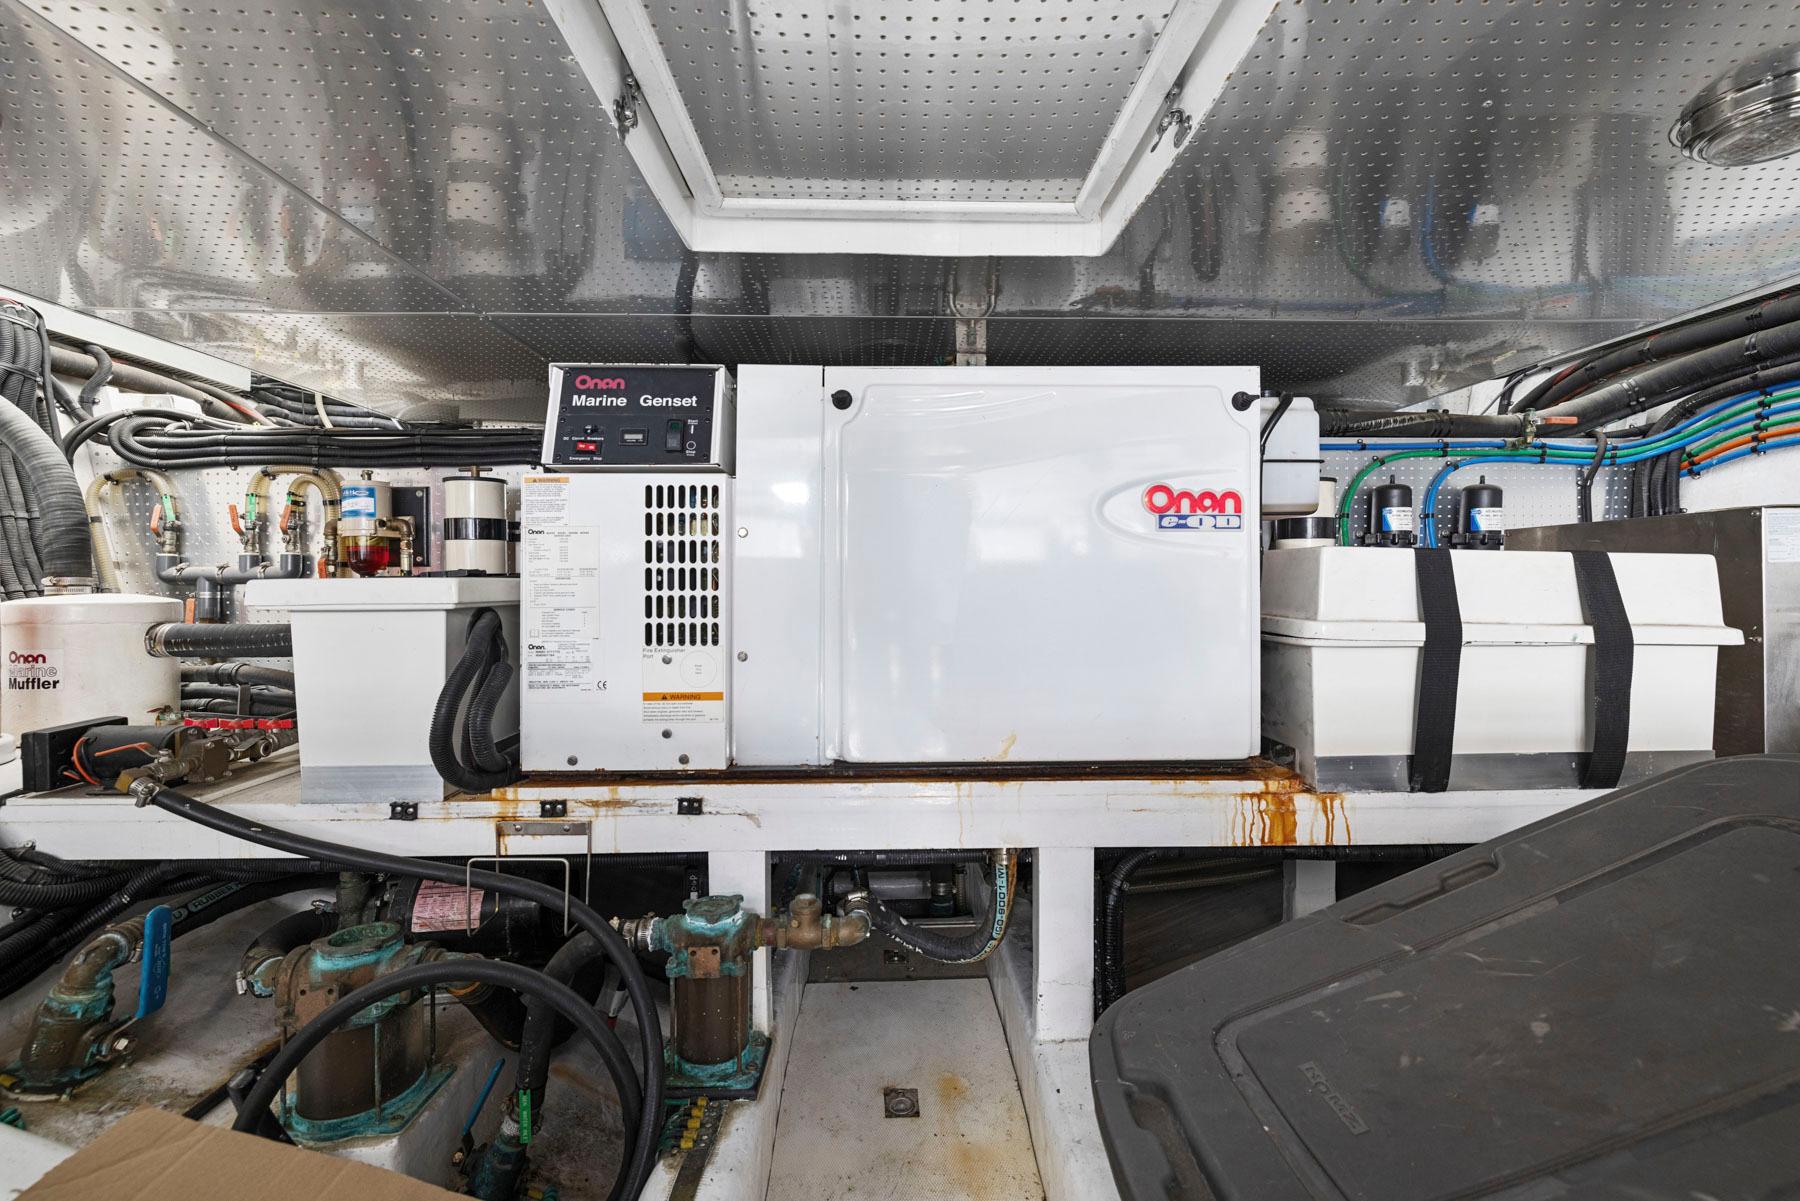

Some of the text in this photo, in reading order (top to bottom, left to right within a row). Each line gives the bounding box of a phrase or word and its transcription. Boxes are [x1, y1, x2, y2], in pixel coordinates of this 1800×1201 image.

[575, 375, 625, 389] Onan
[572, 394, 698, 407] Marine Genset
[1144, 484, 1242, 514] Onan
[1160, 515, 1241, 529] e-QD
[9, 651, 46, 663] Onan
[9, 678, 59, 689] Muffler
